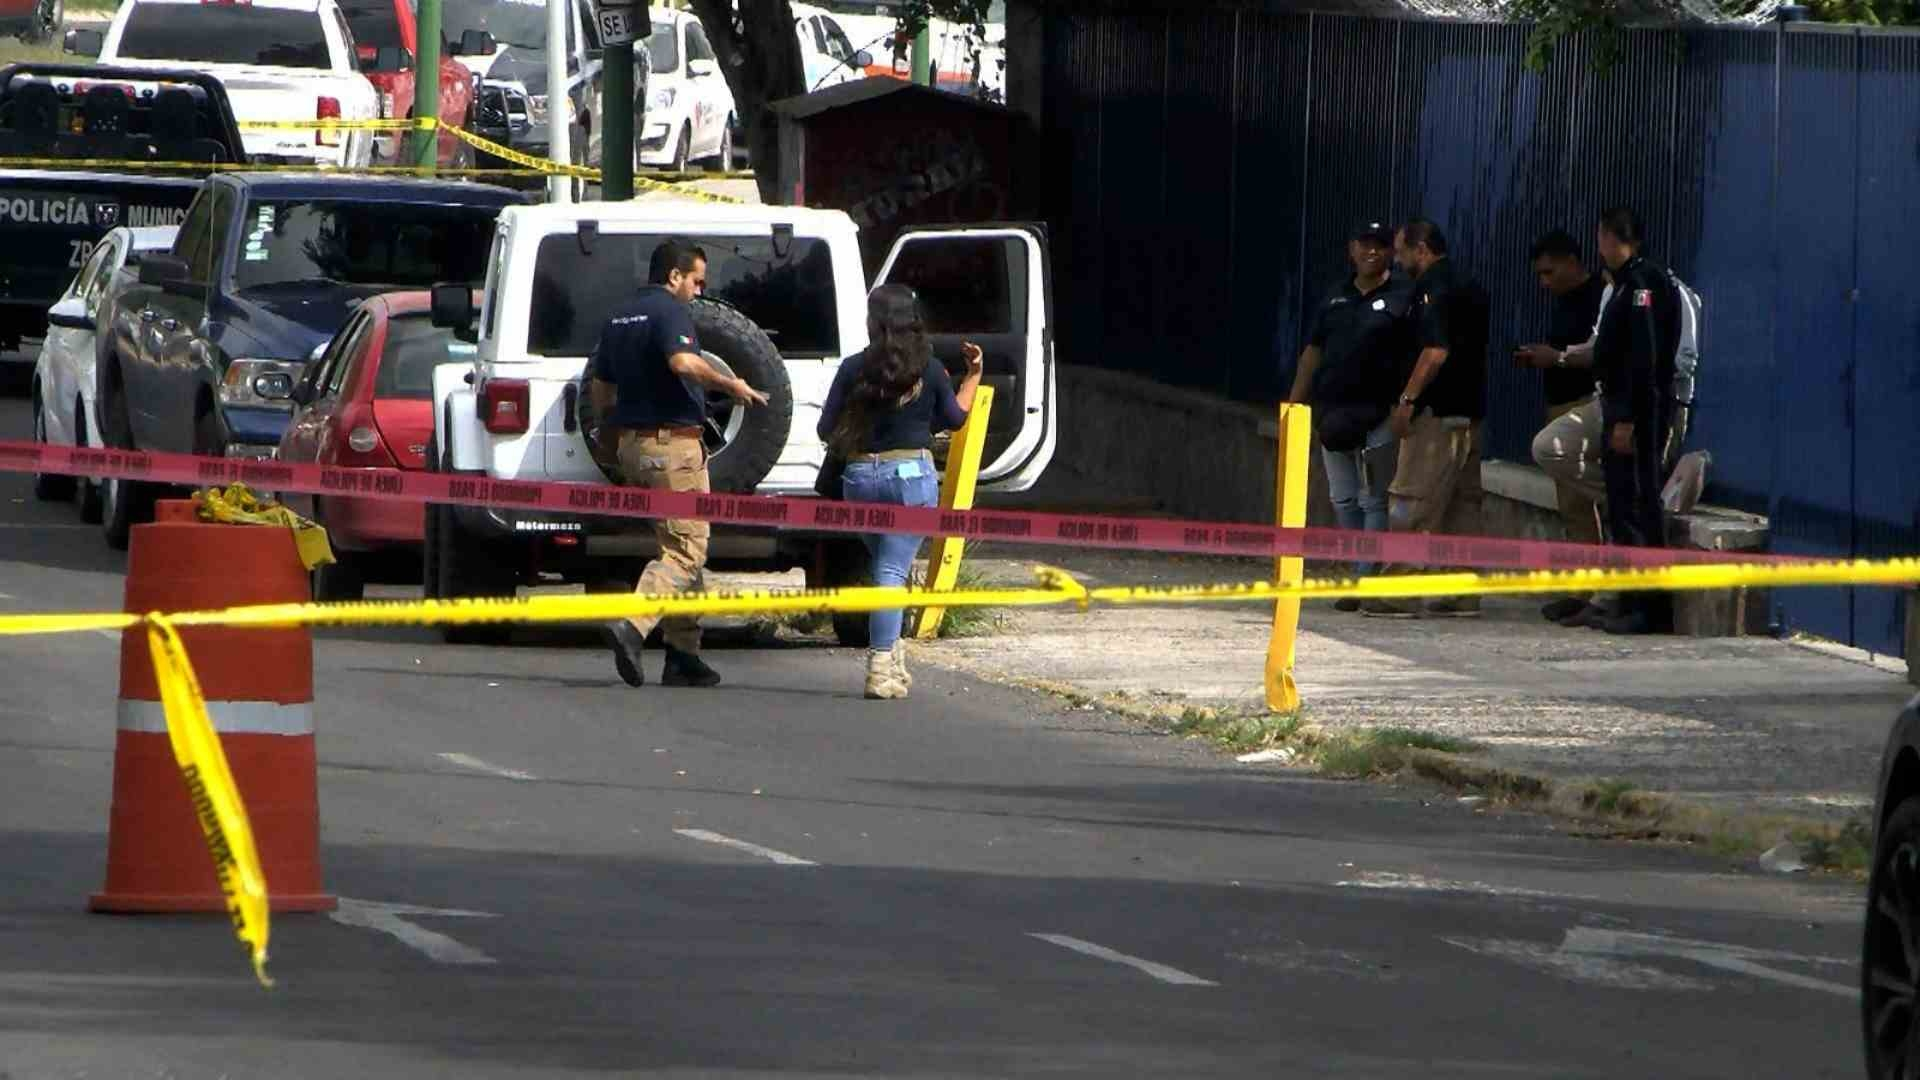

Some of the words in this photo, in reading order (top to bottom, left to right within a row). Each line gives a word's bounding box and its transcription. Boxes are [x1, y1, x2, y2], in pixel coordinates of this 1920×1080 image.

[603, 15, 621, 36] SE
[0, 197, 89, 224] POLICÍA
[128, 205, 185, 227] MUNIC
